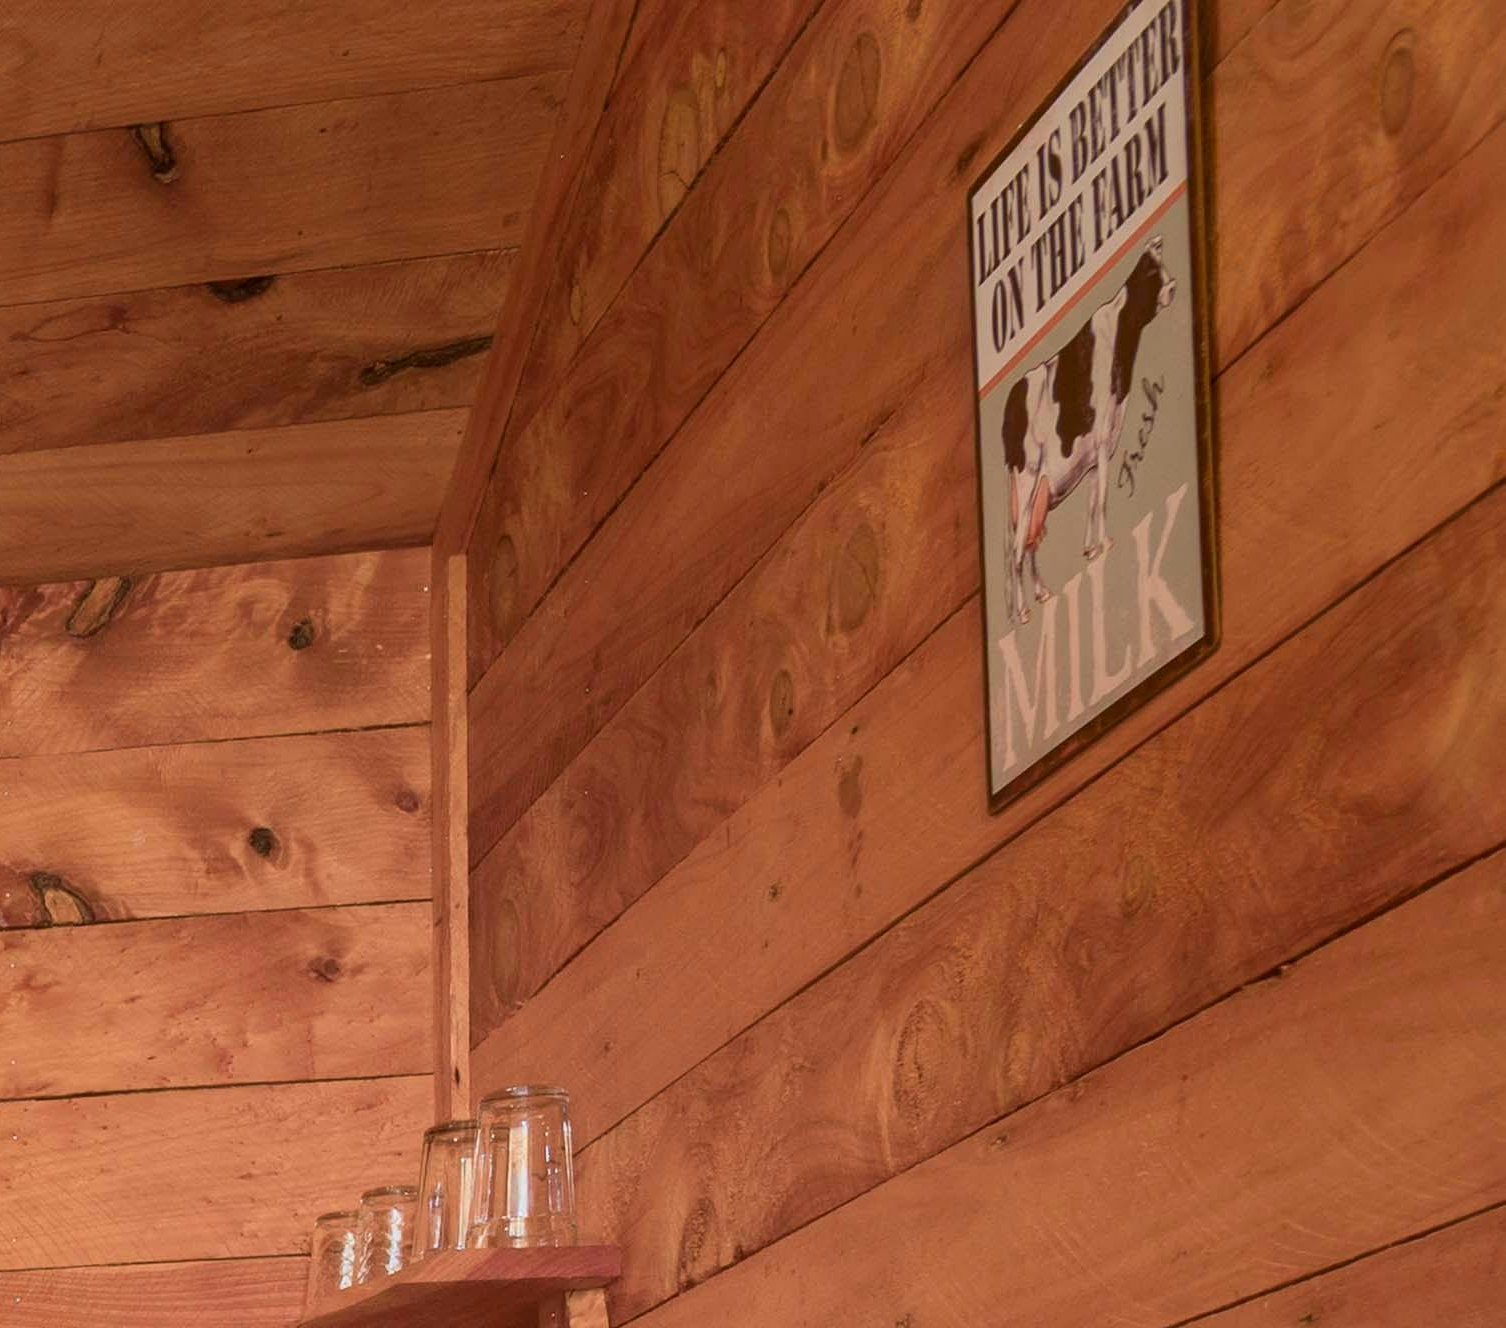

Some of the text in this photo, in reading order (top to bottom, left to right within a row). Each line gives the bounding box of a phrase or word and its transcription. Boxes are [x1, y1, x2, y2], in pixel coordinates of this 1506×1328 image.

[977, 0, 1181, 287] LIFE IS BETTER
[992, 102, 1169, 354] ON THE FARM
[1117, 374, 1166, 497] Fresh
[998, 483, 1195, 771] MILK
